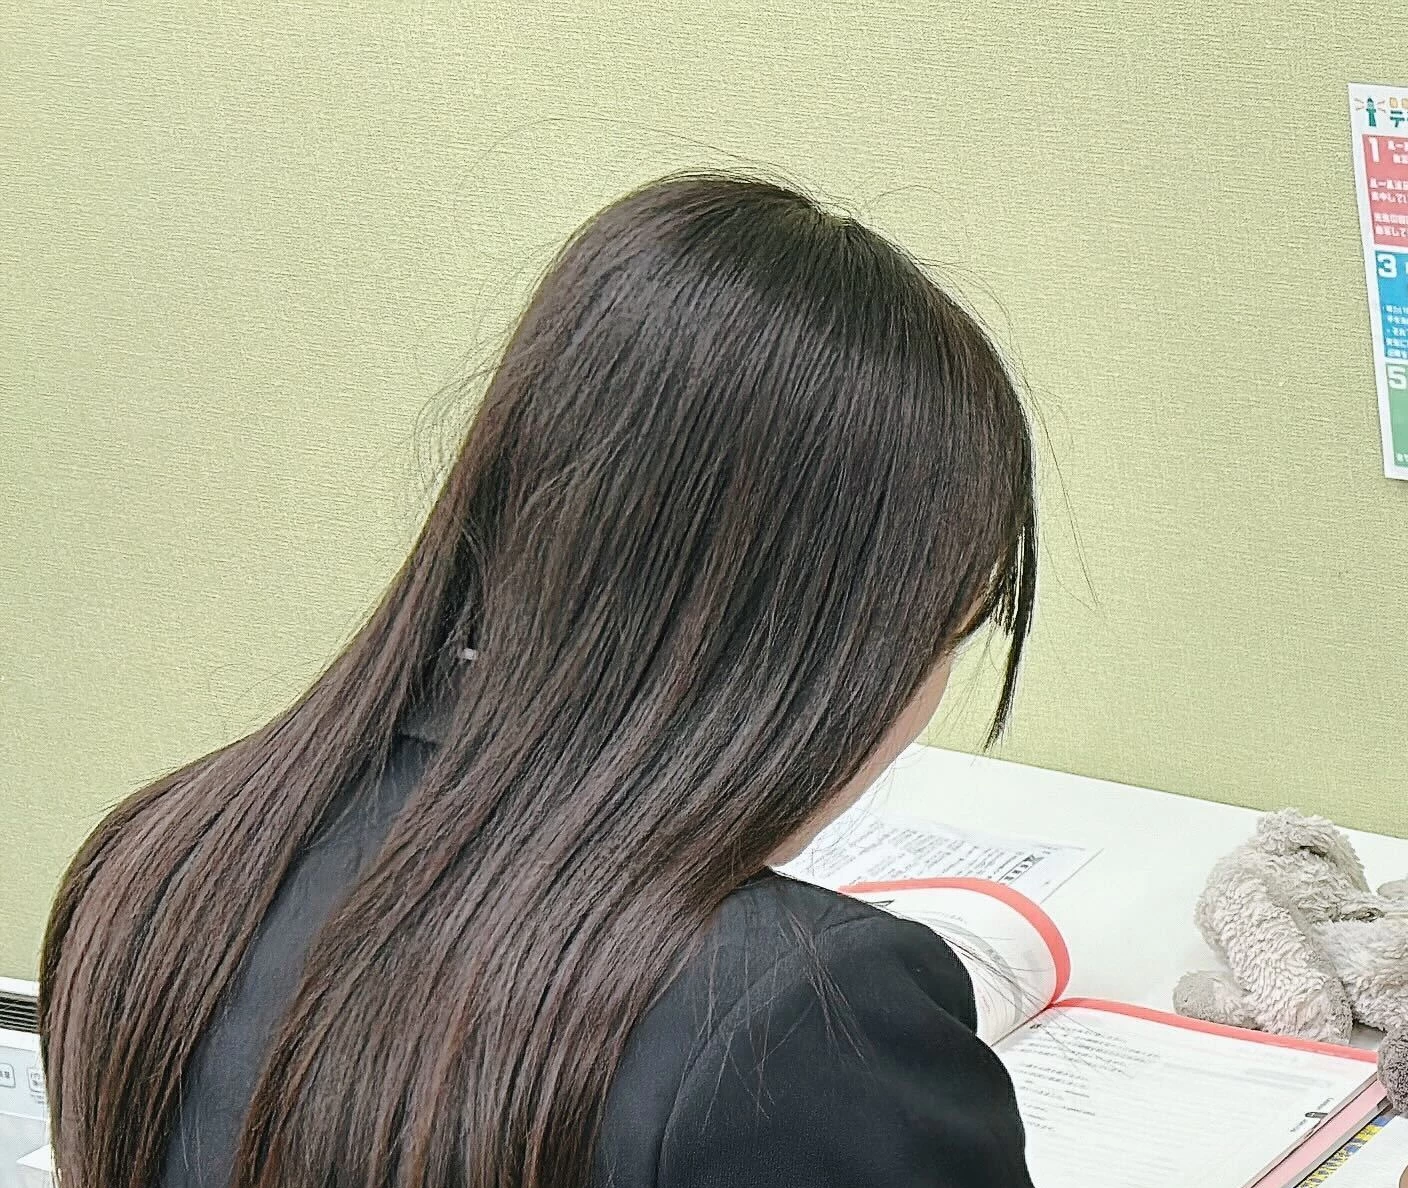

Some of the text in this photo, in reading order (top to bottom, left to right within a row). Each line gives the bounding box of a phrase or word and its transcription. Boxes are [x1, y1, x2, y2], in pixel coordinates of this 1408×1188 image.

[1369, 137, 1380, 163] 1
[1376, 253, 1397, 278] 3
[1387, 365, 1407, 390] 5
